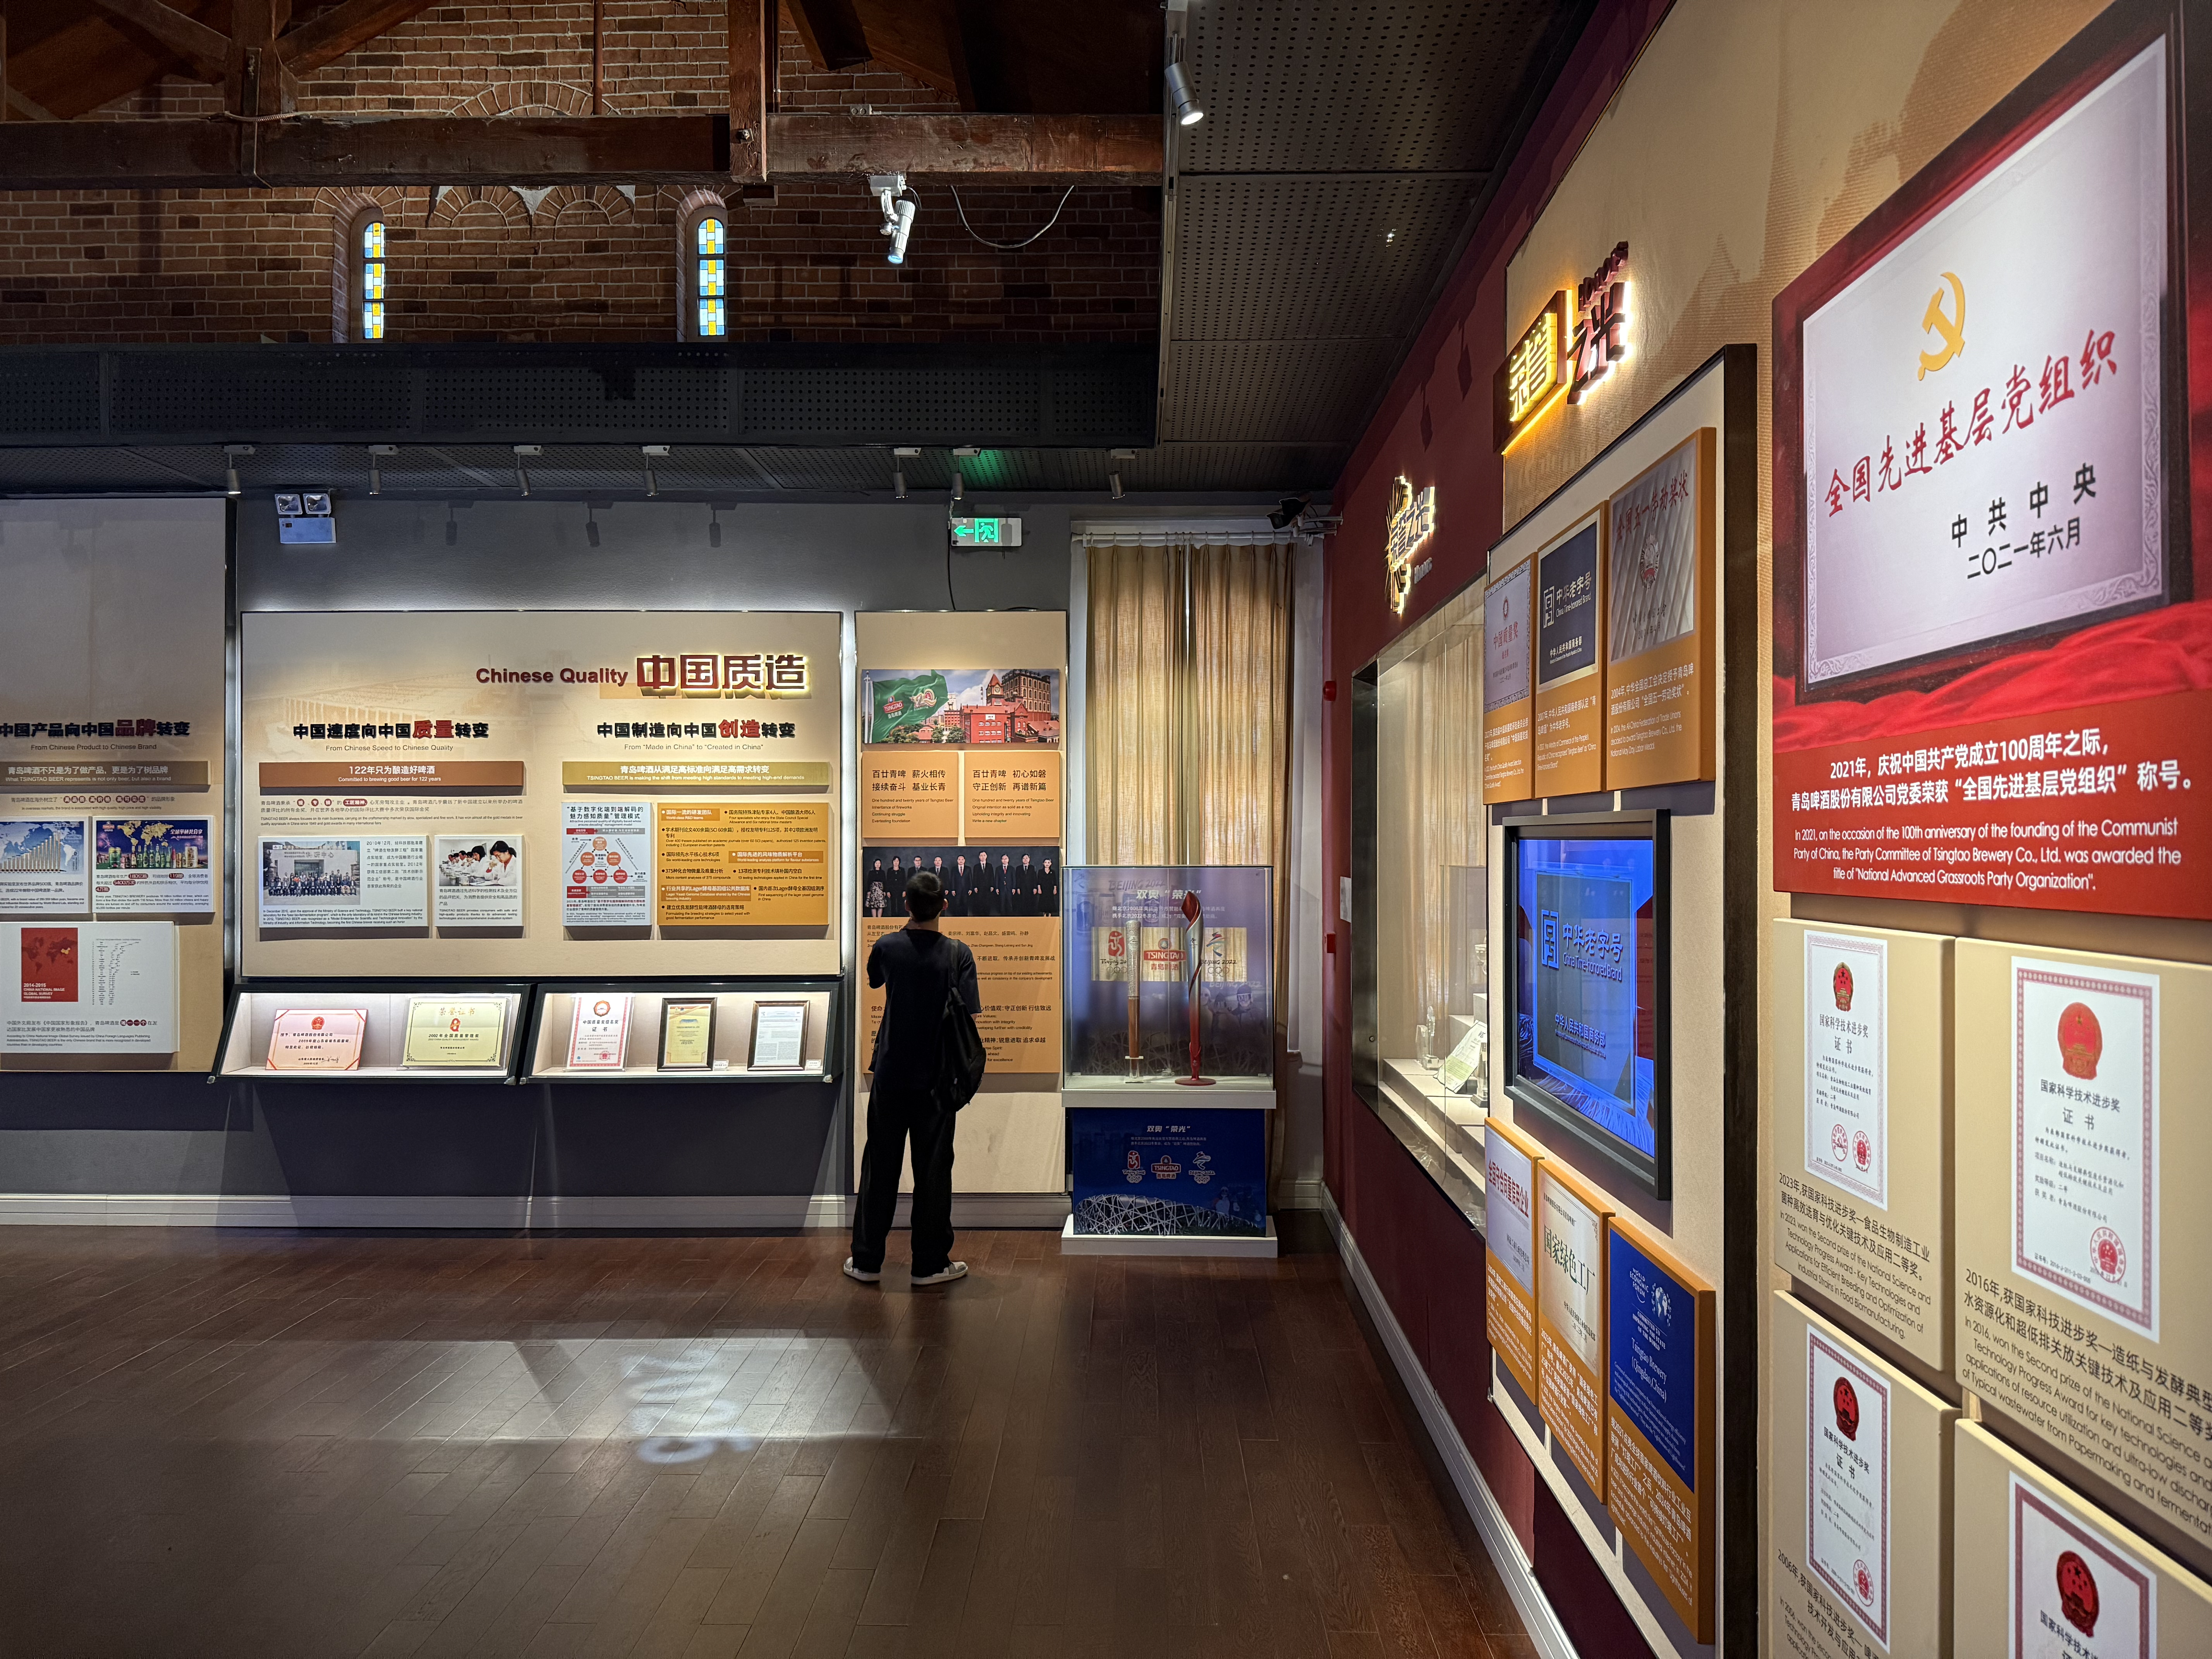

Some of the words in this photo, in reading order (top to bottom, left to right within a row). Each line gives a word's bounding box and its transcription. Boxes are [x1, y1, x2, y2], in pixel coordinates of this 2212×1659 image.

[1824, 329, 2116, 518] 全国先进基层党组织
[1616, 470, 1689, 542] 全国五一劳动奖状
[1556, 571, 1592, 606] 中华老字号
[1556, 608, 1564, 618] China
[1493, 621, 1518, 650] 中国质量奖
[1549, 636, 1582, 658] 中华人民共和国商务部
[476, 668, 553, 683] Chinese
[560, 668, 628, 687] Quality
[636, 654, 808, 690] 中国质造
[0, 719, 190, 737] 中国产品向中国品牌转变
[293, 720, 489, 739] 中国速度向中国质量转变
[597, 719, 796, 738] 中国制造向中国创造转变
[349, 766, 434, 774] 122年只为酿造好啤酒
[620, 765, 769, 773] 青岛啤酒从满足高标准向满足高需求转变
[973, 769, 1006, 778] 百廿青啤
[1013, 769, 1046, 778] 初心如磐
[912, 782, 945, 790] 基业长青
[1013, 782, 1046, 790] 再谱新篇
[1795, 830, 1800, 840] In
[1802, 829, 1817, 841] 2021,
[1819, 831, 1827, 840] on
[1829, 828, 1840, 840] the
[1842, 827, 1874, 840] occasion
[1876, 826, 1884, 839] of
[1886, 826, 1899, 839] the
[1902, 826, 1922, 839] 100th
[1925, 824, 1976, 841] anniversary
[1978, 823, 1988, 838] of
[1990, 823, 2008, 837] the
[2010, 821, 2059, 840] founding
[2062, 820, 2074, 836] of
[2077, 820, 2098, 836] the
[2101, 817, 2178, 836] Communist
[1794, 848, 1809, 861] Party
[1811, 847, 1817, 859] of
[1819, 847, 1840, 860] China,
[1842, 847, 1853, 859] the
[1855, 847, 1874, 862] Party
[1875, 847, 1920, 860] Committee
[1922, 847, 1931, 860] of
[1933, 847, 1970, 864] Tsingtao
[1973, 847, 2013, 865] Brewery
[2041, 847, 2061, 862] Ltd.
[2064, 850, 2088, 862] was
[2092, 847, 2153, 863] awarded
[2158, 847, 2181, 864] the
[1833, 867, 1845, 879] title
[1847, 867, 1854, 879] of
[1890, 869, 1935, 883] Advanced
[1937, 869, 1985, 885] Grassroots
[1987, 871, 2013, 888] Party
[1563, 922, 1623, 963] 中华老字号
[1563, 951, 1575, 968] China
[1555, 1012, 1606, 1049] 中华人民共和国商务部
[1819, 1013, 1869, 1038] 国家科学技术进步奖
[1834, 1035, 1852, 1054] 证书
[2041, 1079, 2120, 1112] 国家科学技术进步奖
[2063, 1107, 2095, 1130] 证书
[1544, 1224, 1595, 1295] 国家绿色工厂
[1632, 1338, 1649, 1363] Tsingtao
[1649, 1355, 1667, 1384] Brewery
[1824, 1426, 1870, 1475] 国家科学技术进步奖
